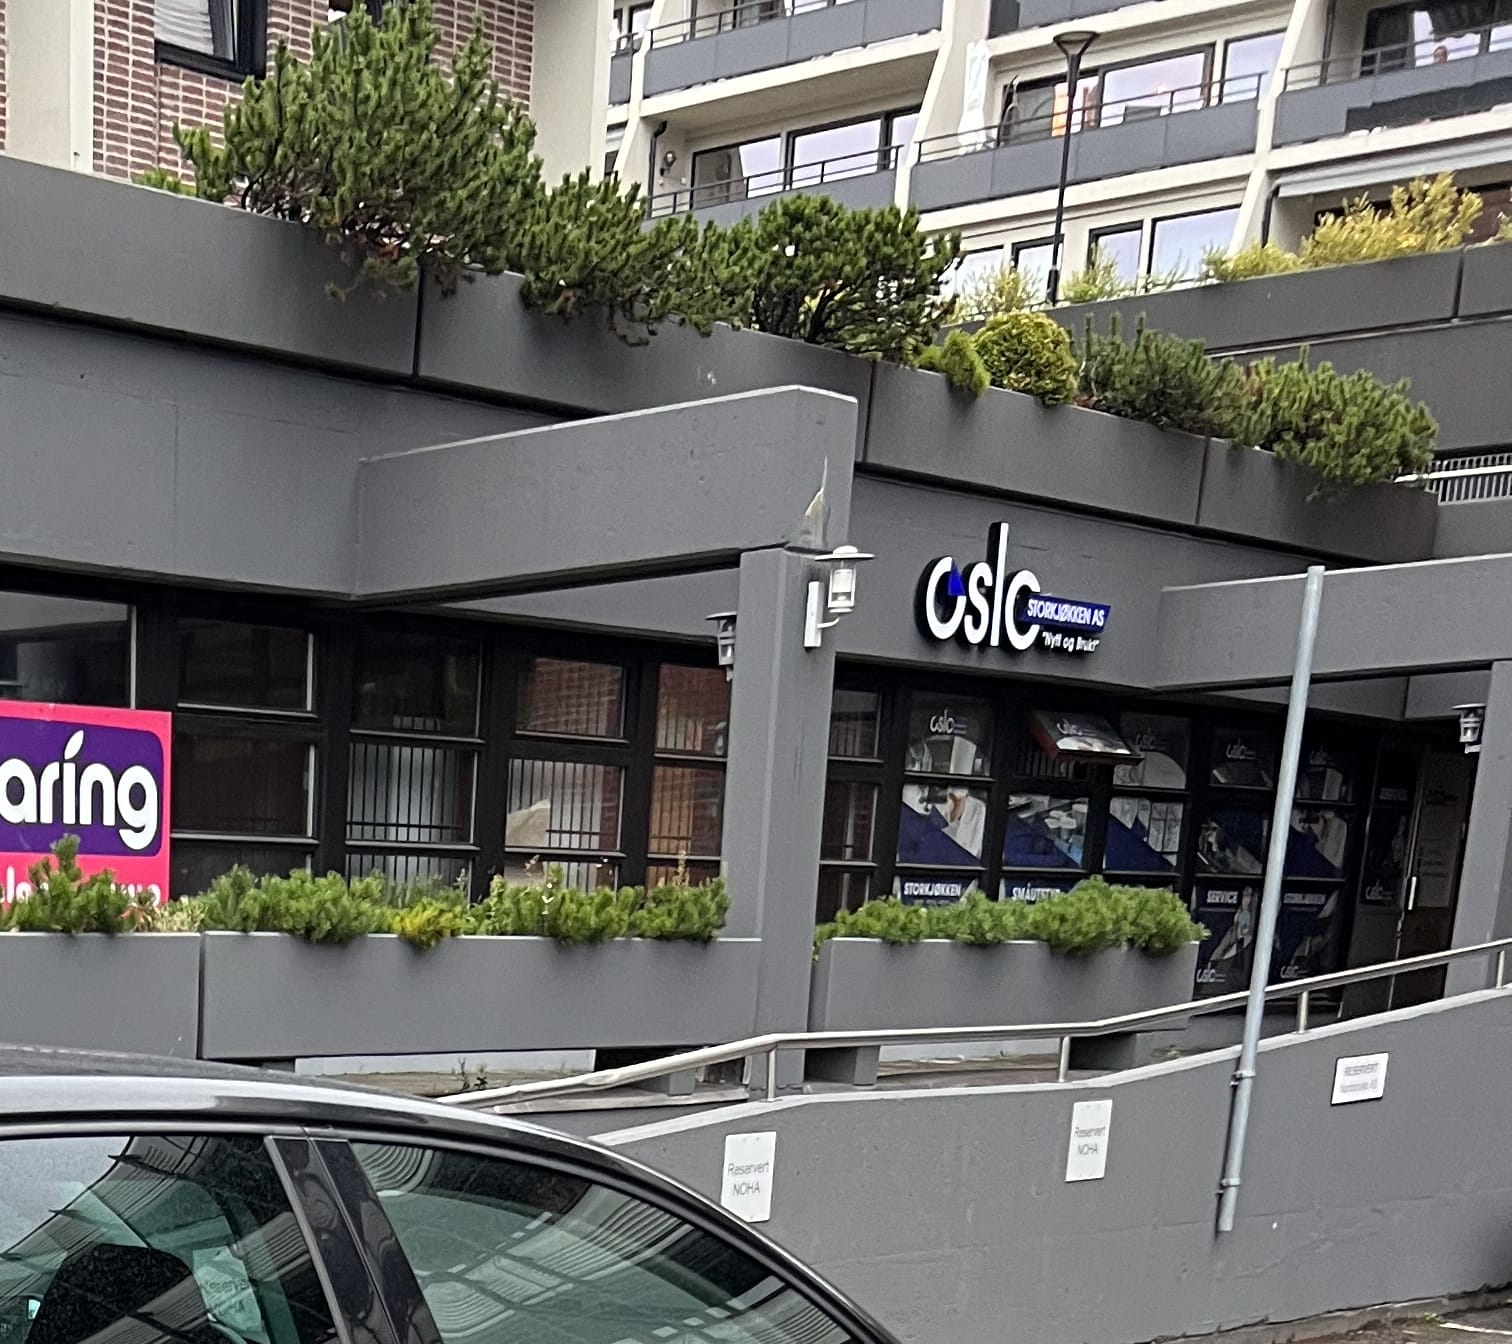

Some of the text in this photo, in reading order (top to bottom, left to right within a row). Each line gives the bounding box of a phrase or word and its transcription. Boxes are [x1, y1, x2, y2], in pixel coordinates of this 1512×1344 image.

[1091, 608, 1105, 628] AS
[1062, 637, 1075, 652] og
[727, 1161, 769, 1176] Reservert
[732, 1182, 760, 1196] NOHA
